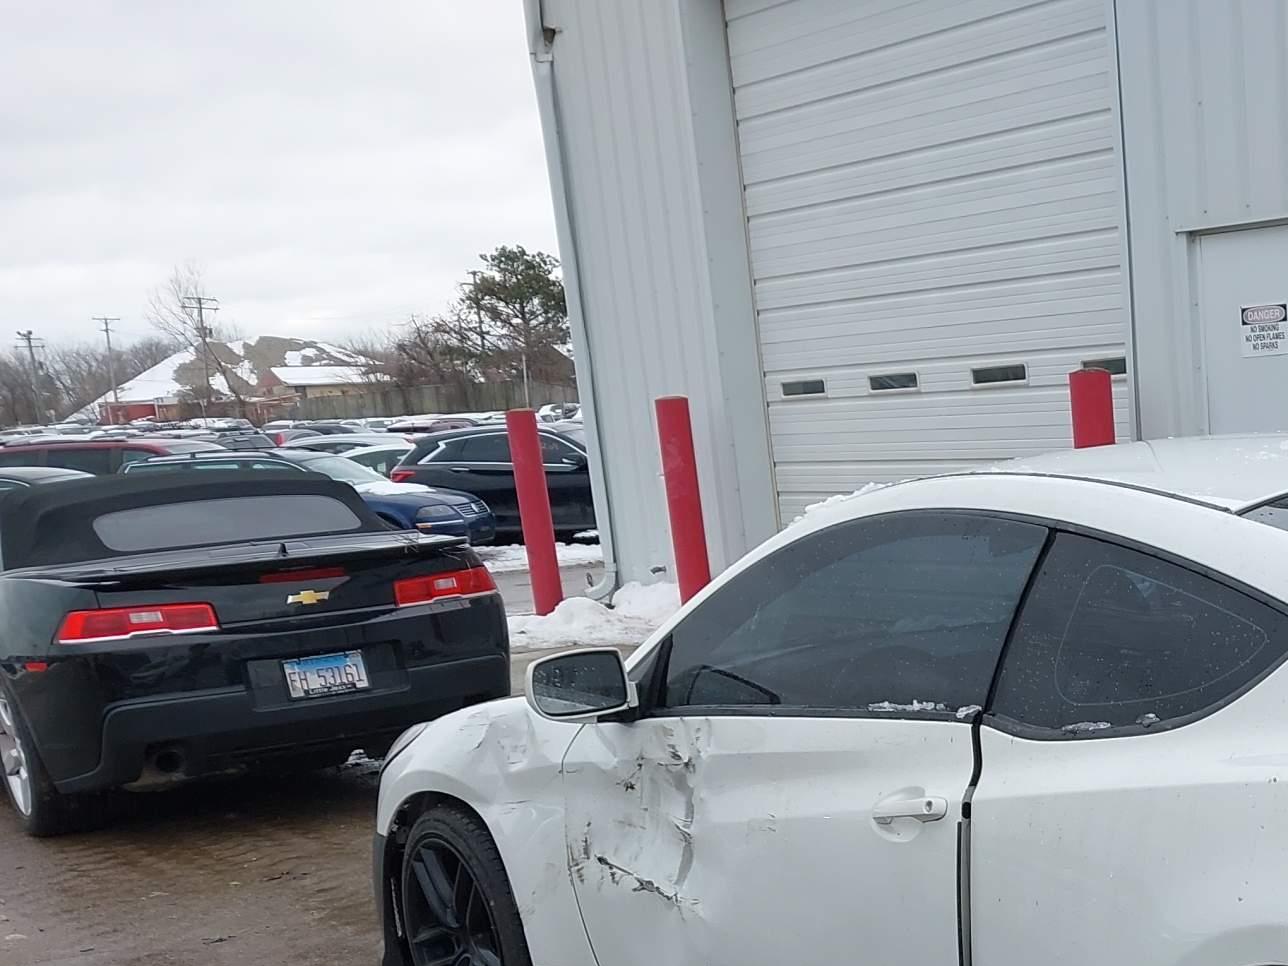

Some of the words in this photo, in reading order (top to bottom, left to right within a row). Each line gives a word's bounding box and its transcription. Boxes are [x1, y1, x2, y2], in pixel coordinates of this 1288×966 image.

[1248, 309, 1280, 320] DANGER
[1266, 332, 1285, 340] FLAMES
[1260, 341, 1278, 349] SPARKS
[316, 664, 364, 686] 53161
